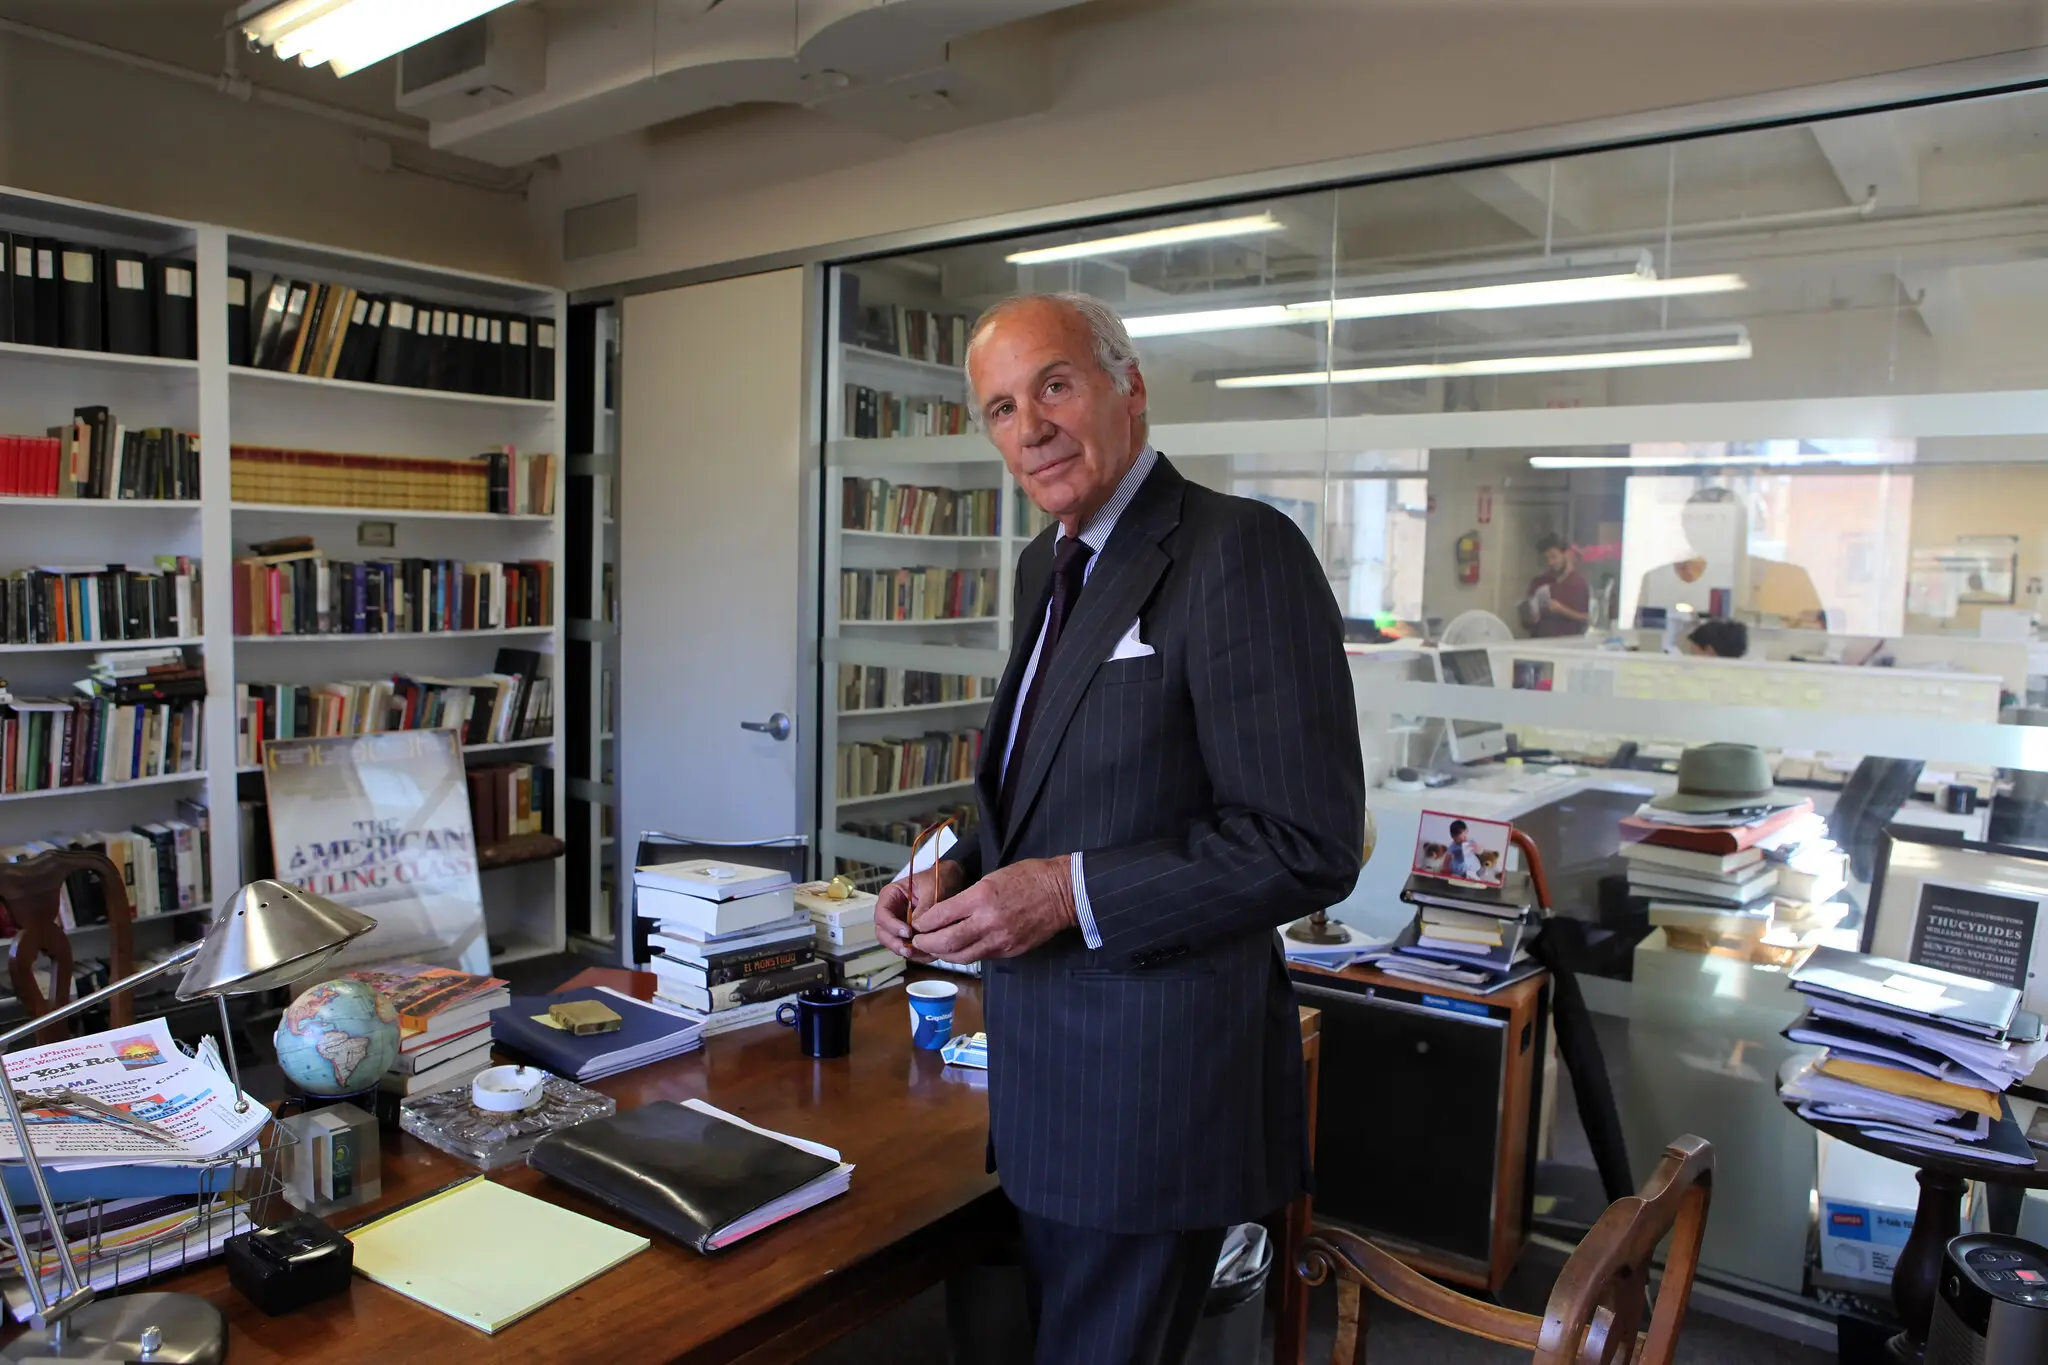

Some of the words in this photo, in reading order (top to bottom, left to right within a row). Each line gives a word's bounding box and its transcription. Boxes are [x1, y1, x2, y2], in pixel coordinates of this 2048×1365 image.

[352, 817, 400, 833] THE
[289, 828, 469, 871] AMERICAN
[1926, 926, 1963, 938] WILLIAM
[1963, 932, 2021, 948] SHAKESPEARE
[1928, 914, 2023, 940] THUCYDIDES
[1923, 941, 1943, 951] SUN
[1967, 949, 2019, 966] VOLTAIRE
[743, 963, 753, 972] EL
[4, 1056, 36, 1067] ney's
[39, 1047, 83, 1059] iPhone
[30, 1060, 84, 1079] York
[83, 1050, 160, 1067] Review
[34, 1051, 87, 1066] Weschler
[49, 1071, 77, 1080] Books
[155, 1067, 190, 1085] Care
[107, 1095, 141, 1103] Drew
[163, 1096, 217, 1123] English
